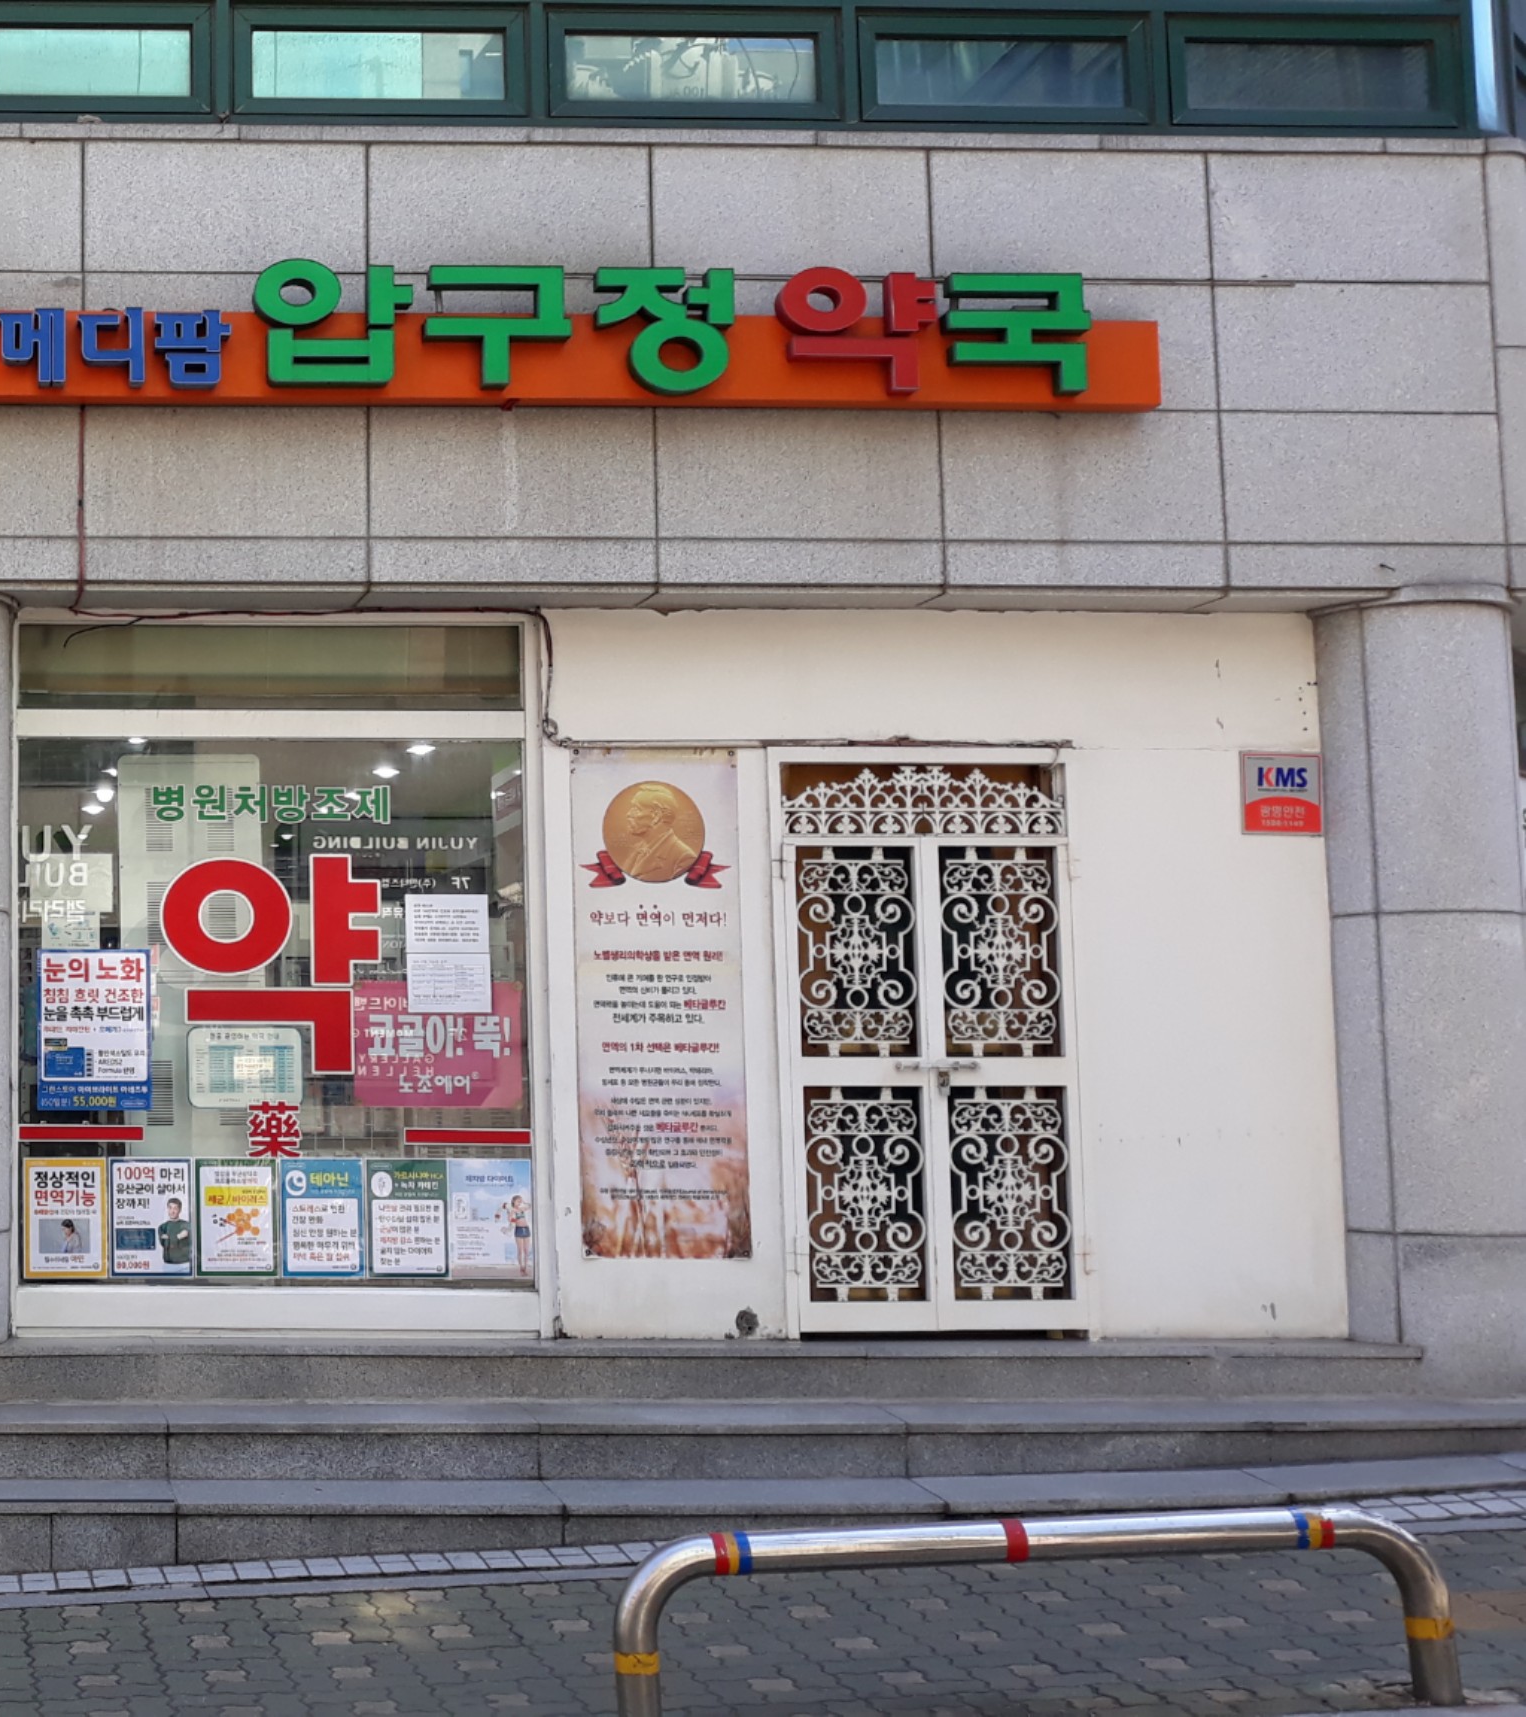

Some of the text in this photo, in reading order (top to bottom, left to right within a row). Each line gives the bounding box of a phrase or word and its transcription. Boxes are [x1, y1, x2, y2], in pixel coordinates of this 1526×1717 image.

[1257, 767, 1308, 787] KMS
[152, 785, 391, 824] 병원처방조제
[589, 910, 727, 928] 약보다 면역이 먼저다!
[44, 958, 145, 983] 눈의 노화
[160, 853, 381, 1074] 약
[44, 988, 144, 1003] 침침 흐릿 건조한
[44, 1006, 144, 1022] 눈을 촉촉 부드럽게
[73, 1096, 116, 1108] 55,000원
[246, 1101, 303, 1158] 藥
[34, 1171, 96, 1189] 정상적인
[117, 1166, 185, 1182] 100억 마리
[309, 1172, 349, 1187] 테아닌
[34, 1189, 96, 1207] 면역기능
[116, 1183, 186, 1195] 유산균이 살아서
[116, 1198, 150, 1209] 장까지!
